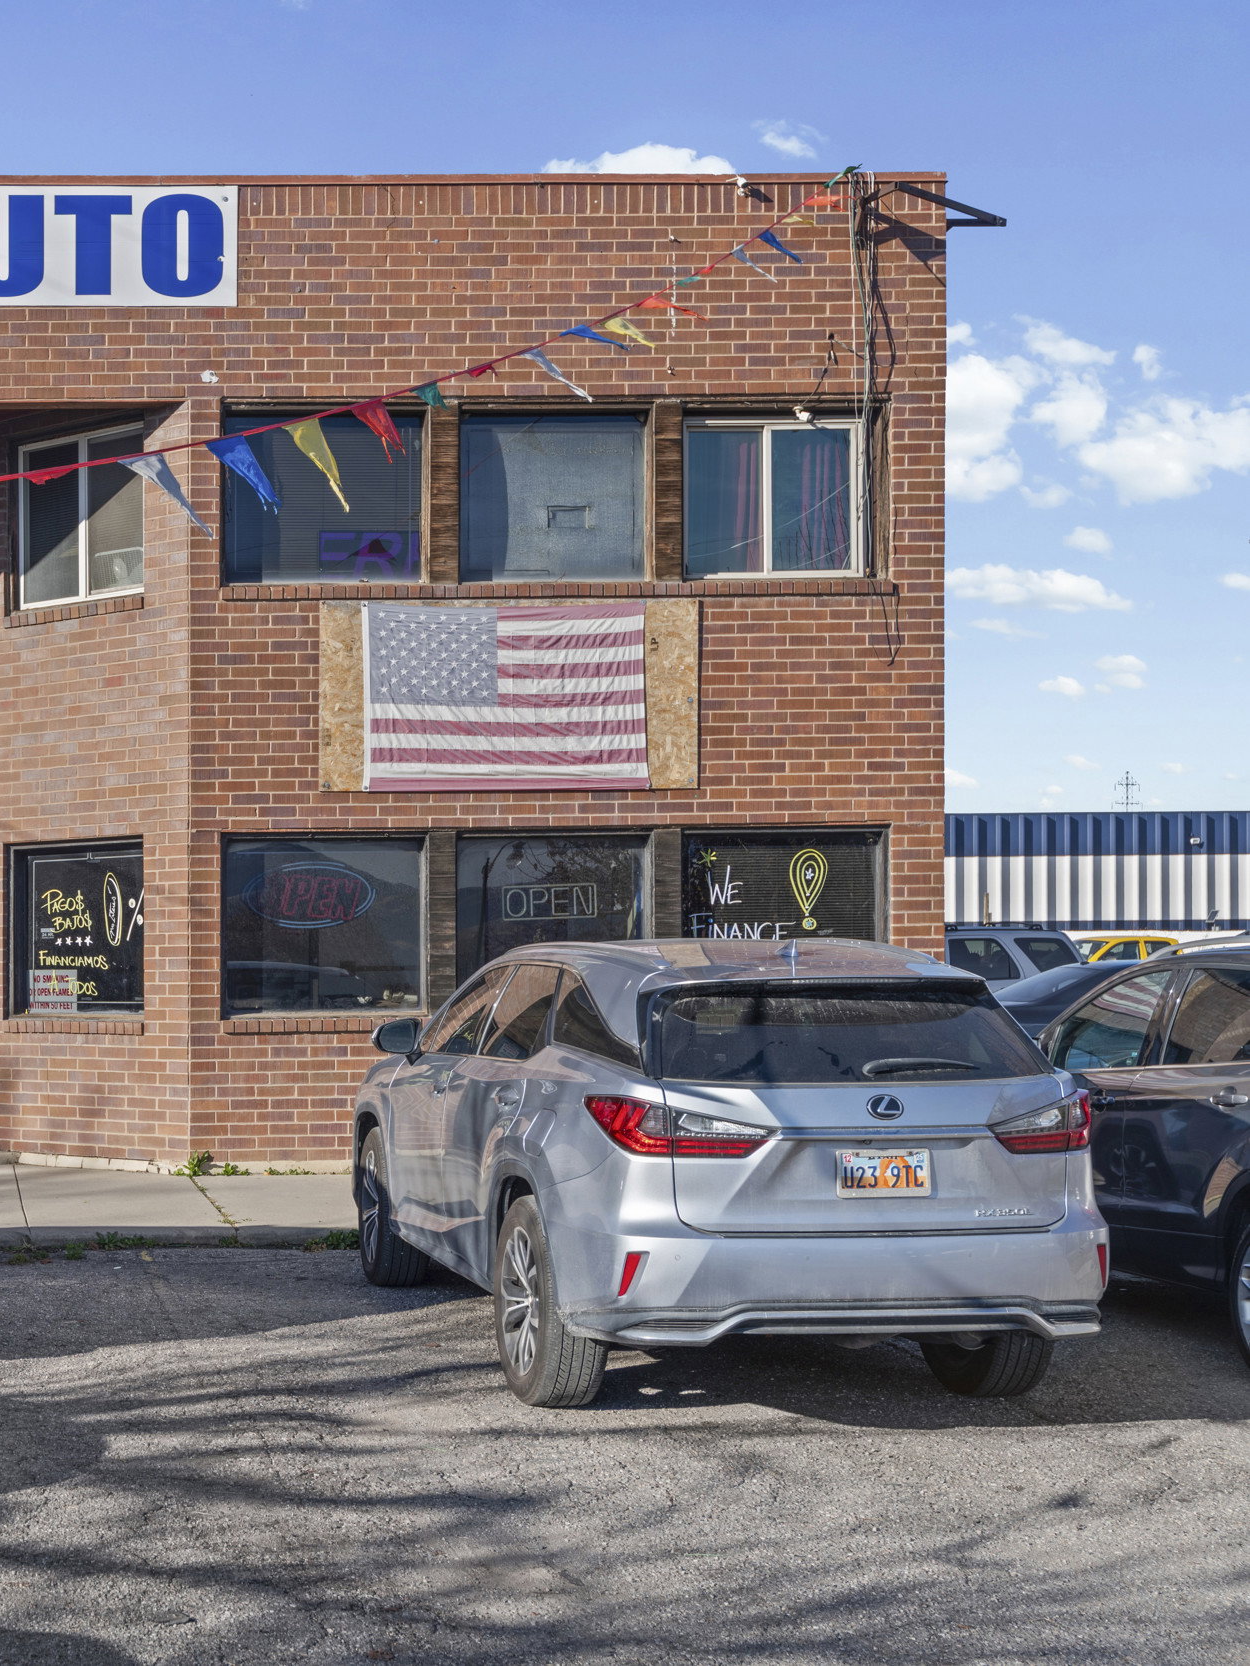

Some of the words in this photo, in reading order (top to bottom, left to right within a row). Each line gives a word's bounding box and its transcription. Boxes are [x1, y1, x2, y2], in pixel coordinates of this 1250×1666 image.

[264, 873, 363, 921] OPEN
[707, 865, 744, 905] WE
[506, 886, 594, 918] OPEN
[38, 949, 109, 970] FINANCIAMOS
[64, 977, 98, 996] TODOS
[59, 1002, 73, 1010] FEET
[843, 1166, 878, 1189] U23
[890, 1164, 924, 1188] 9TC
